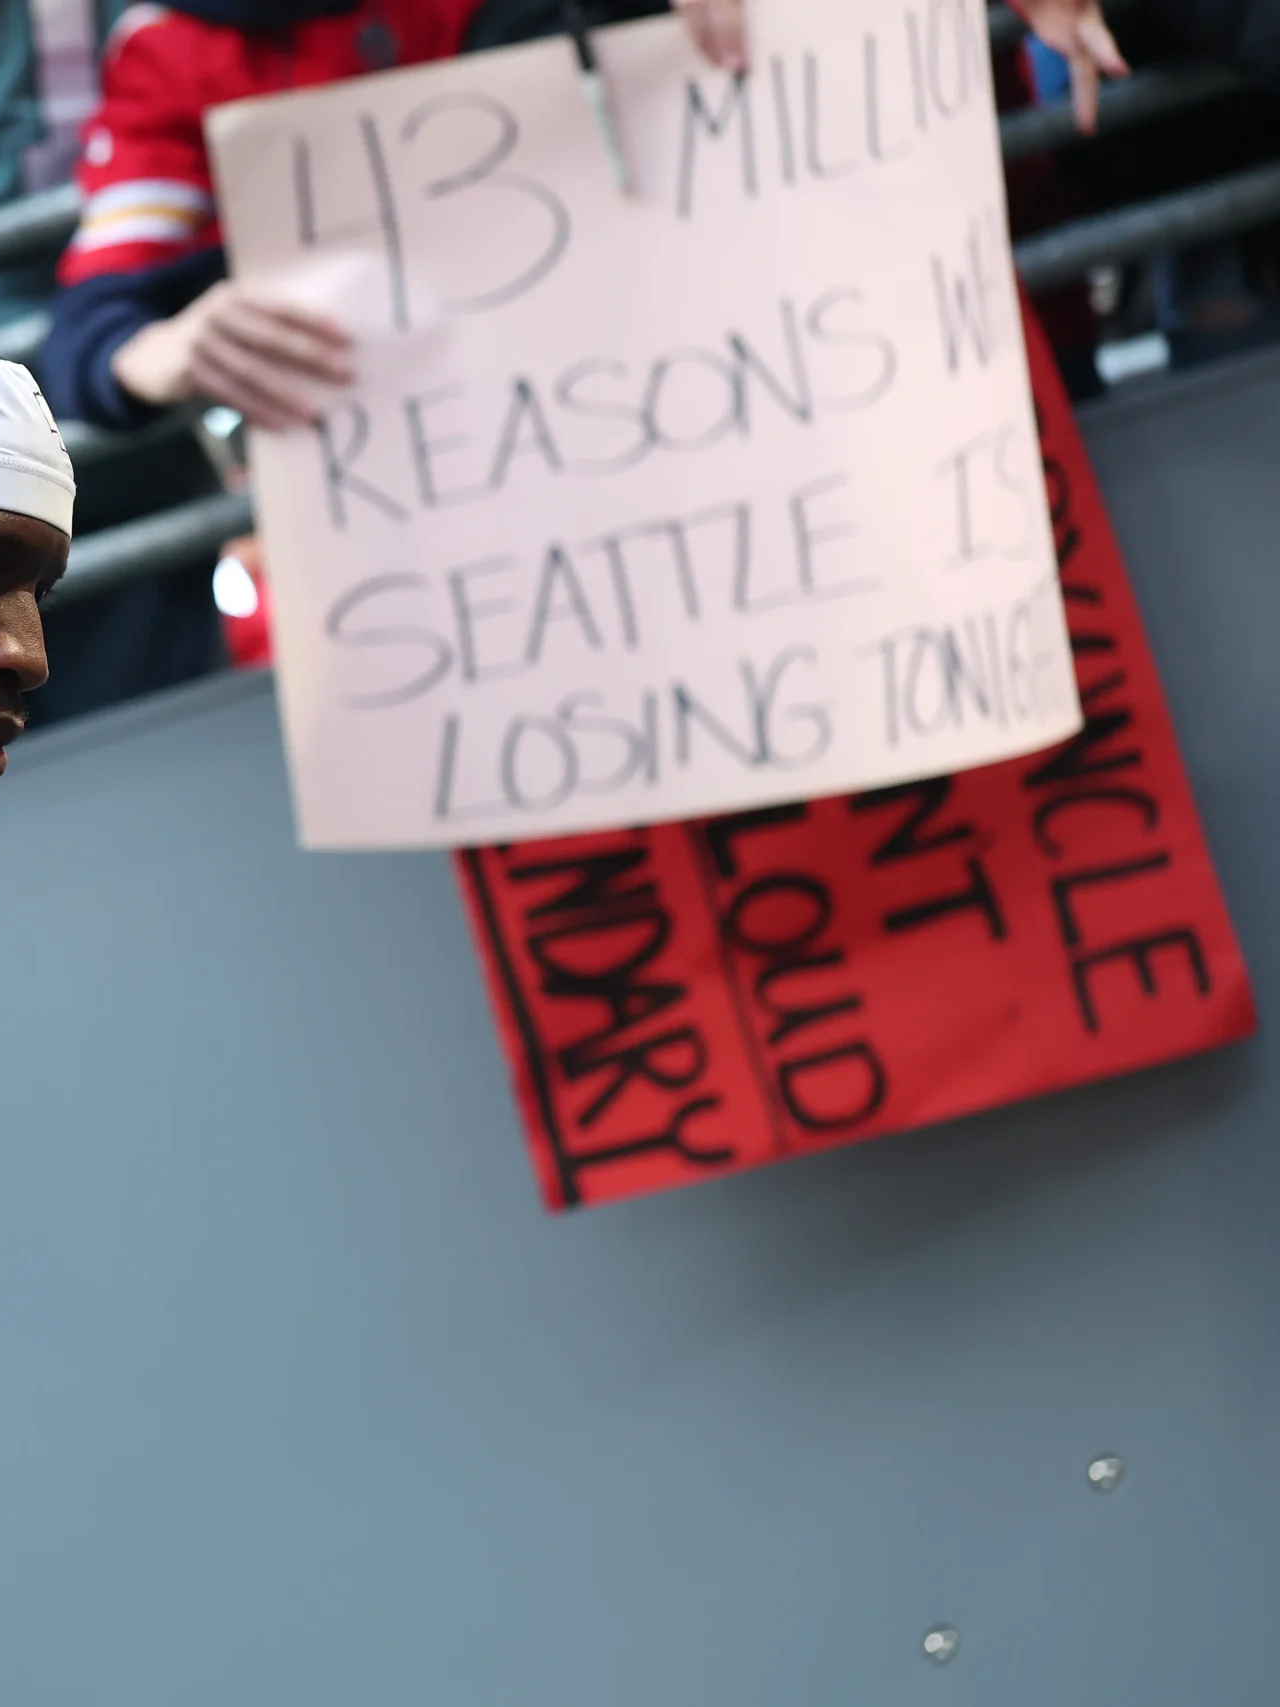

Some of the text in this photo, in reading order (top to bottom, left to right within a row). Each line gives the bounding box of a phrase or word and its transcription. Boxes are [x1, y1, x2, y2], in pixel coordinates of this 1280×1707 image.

[292, 92, 572, 333] 43
[314, 282, 900, 532] REASONS
[323, 472, 886, 710] SEATTLE
[930, 418, 1038, 572] IS
[432, 640, 835, 822] LOSING
[497, 826, 736, 1168] NDARY
[704, 800, 888, 1134] LOUD
